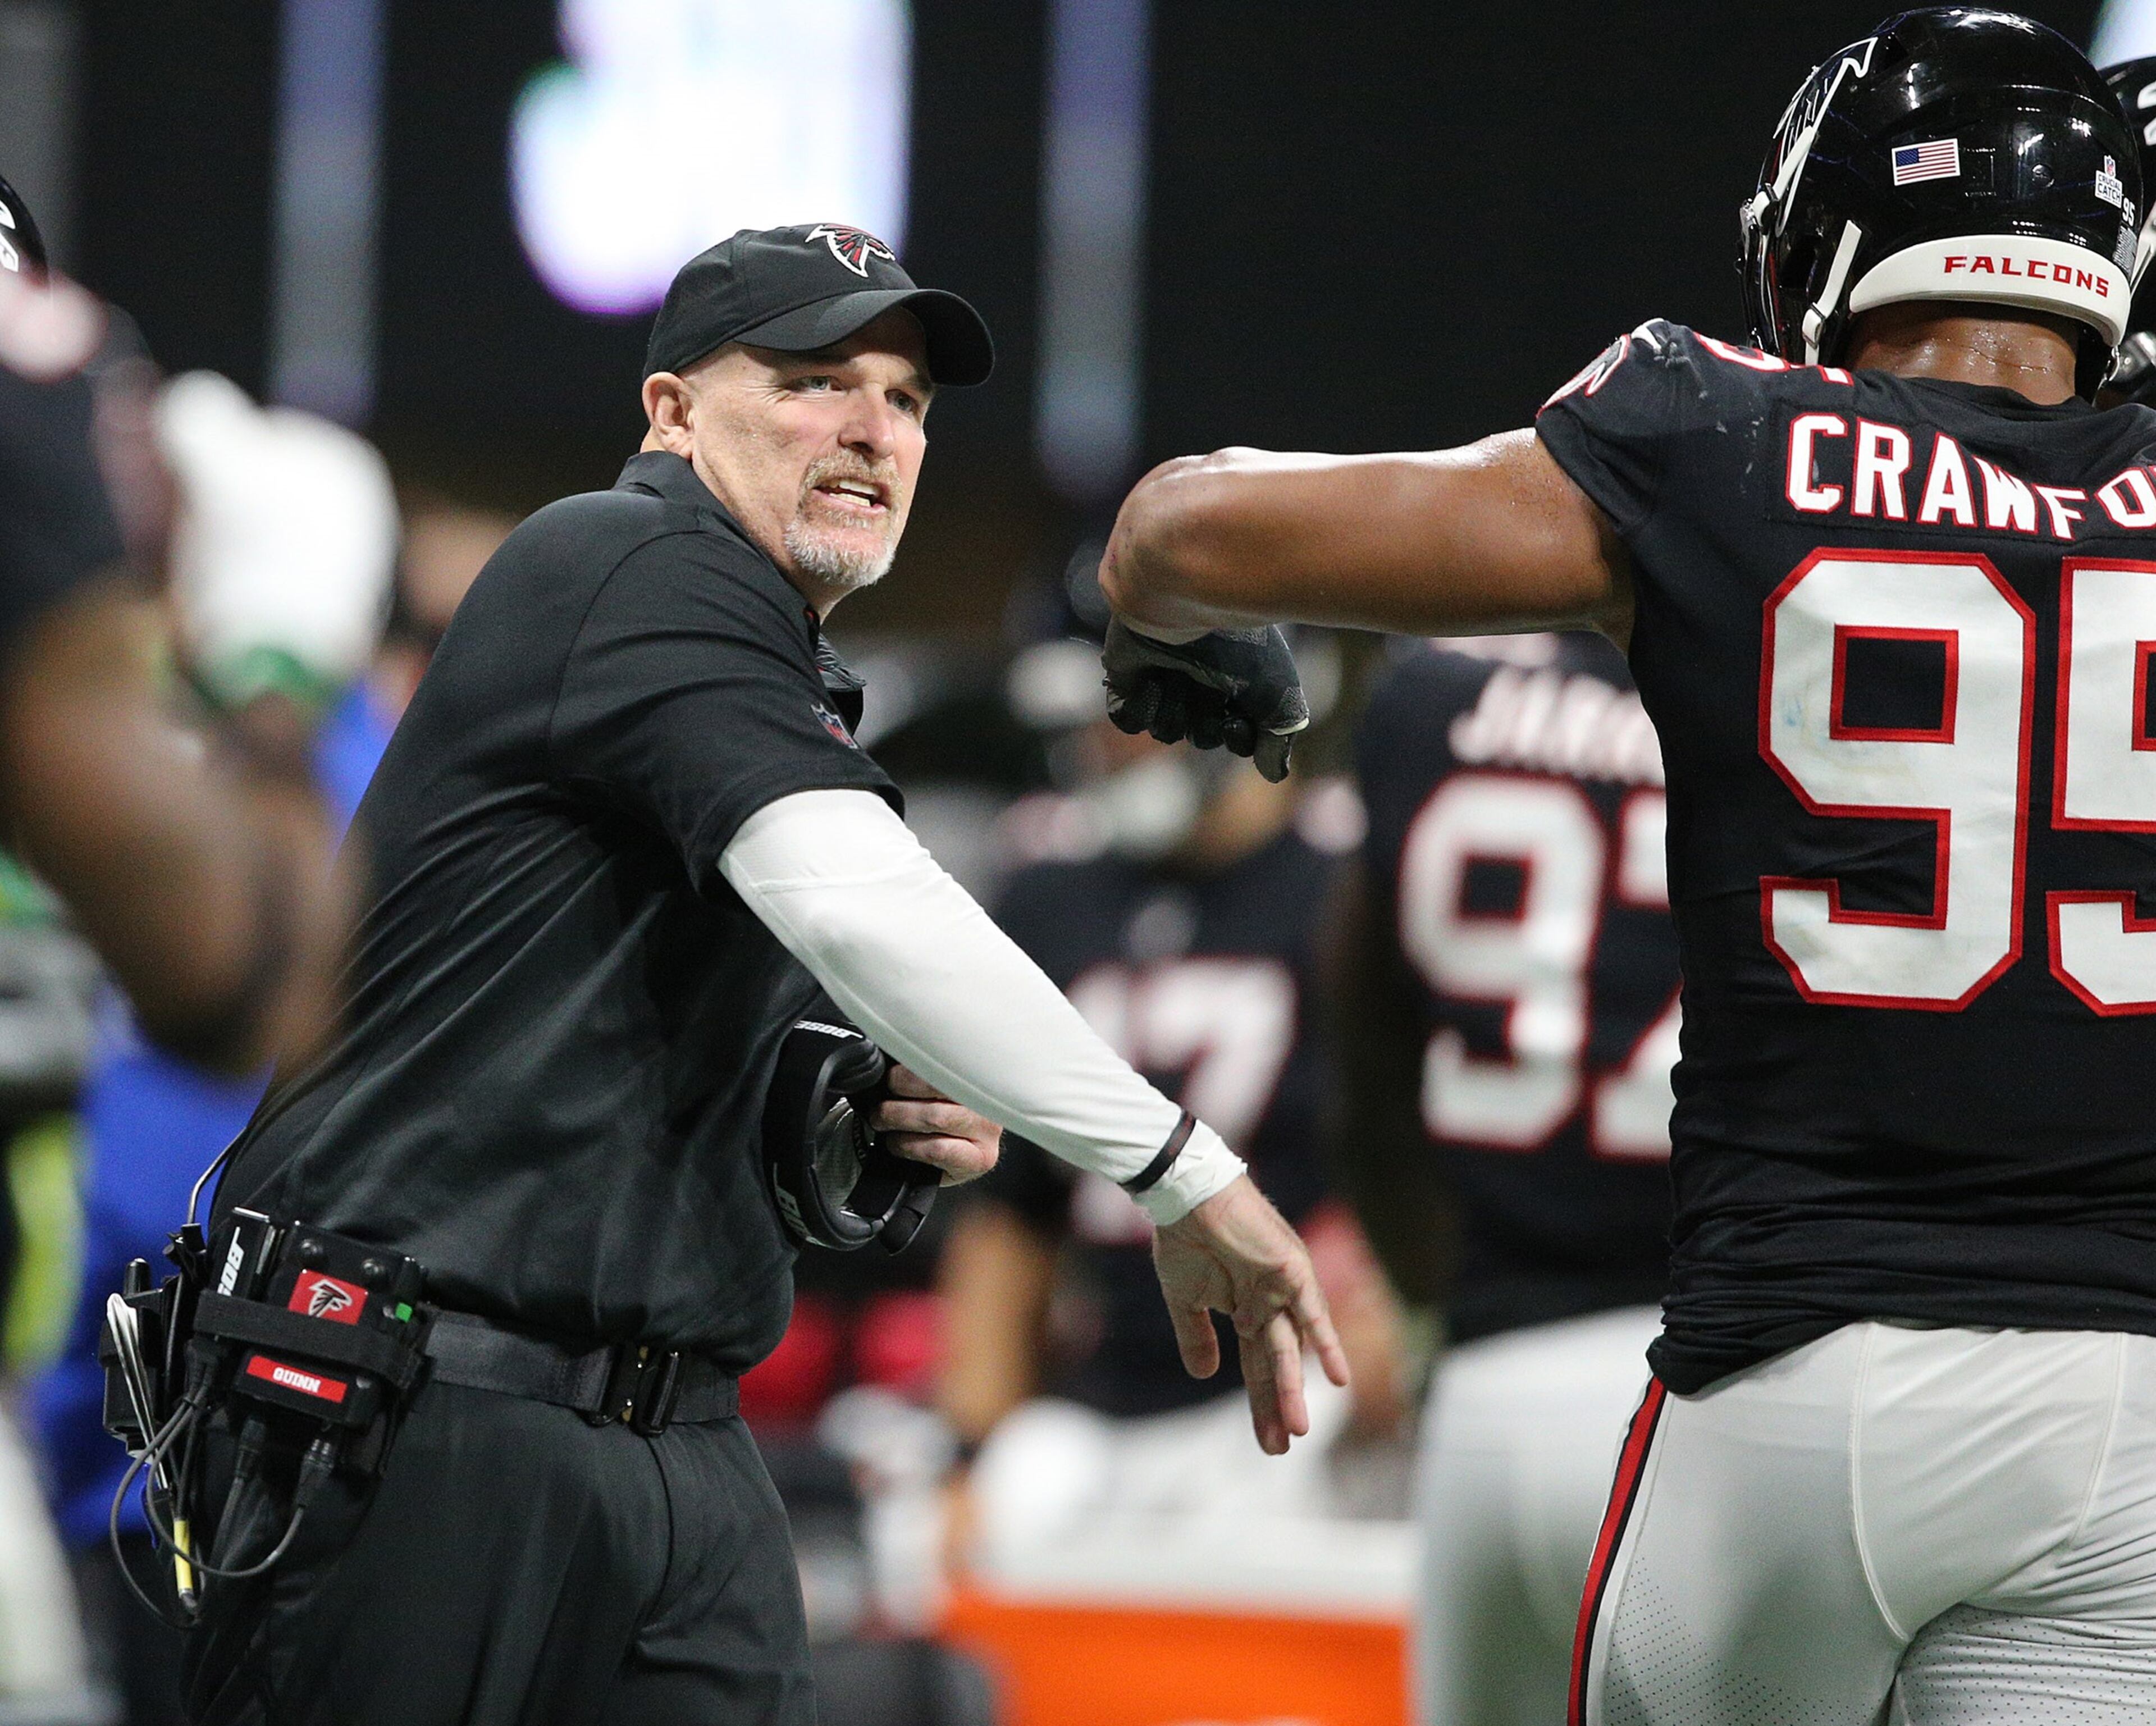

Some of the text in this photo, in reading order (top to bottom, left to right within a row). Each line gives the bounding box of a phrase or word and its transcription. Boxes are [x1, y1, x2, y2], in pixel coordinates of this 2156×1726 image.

[2097, 182, 2121, 203] CATCH
[2098, 174, 2121, 191] CRUCIAL
[2122, 197, 2135, 226] 95
[1943, 256, 2109, 298] FALCONS
[1785, 412, 2156, 541] CRAWFO
[793, 1020, 864, 1039] BOSE
[217, 1226, 245, 1297] BO
[272, 1367, 321, 1393] QUINN
